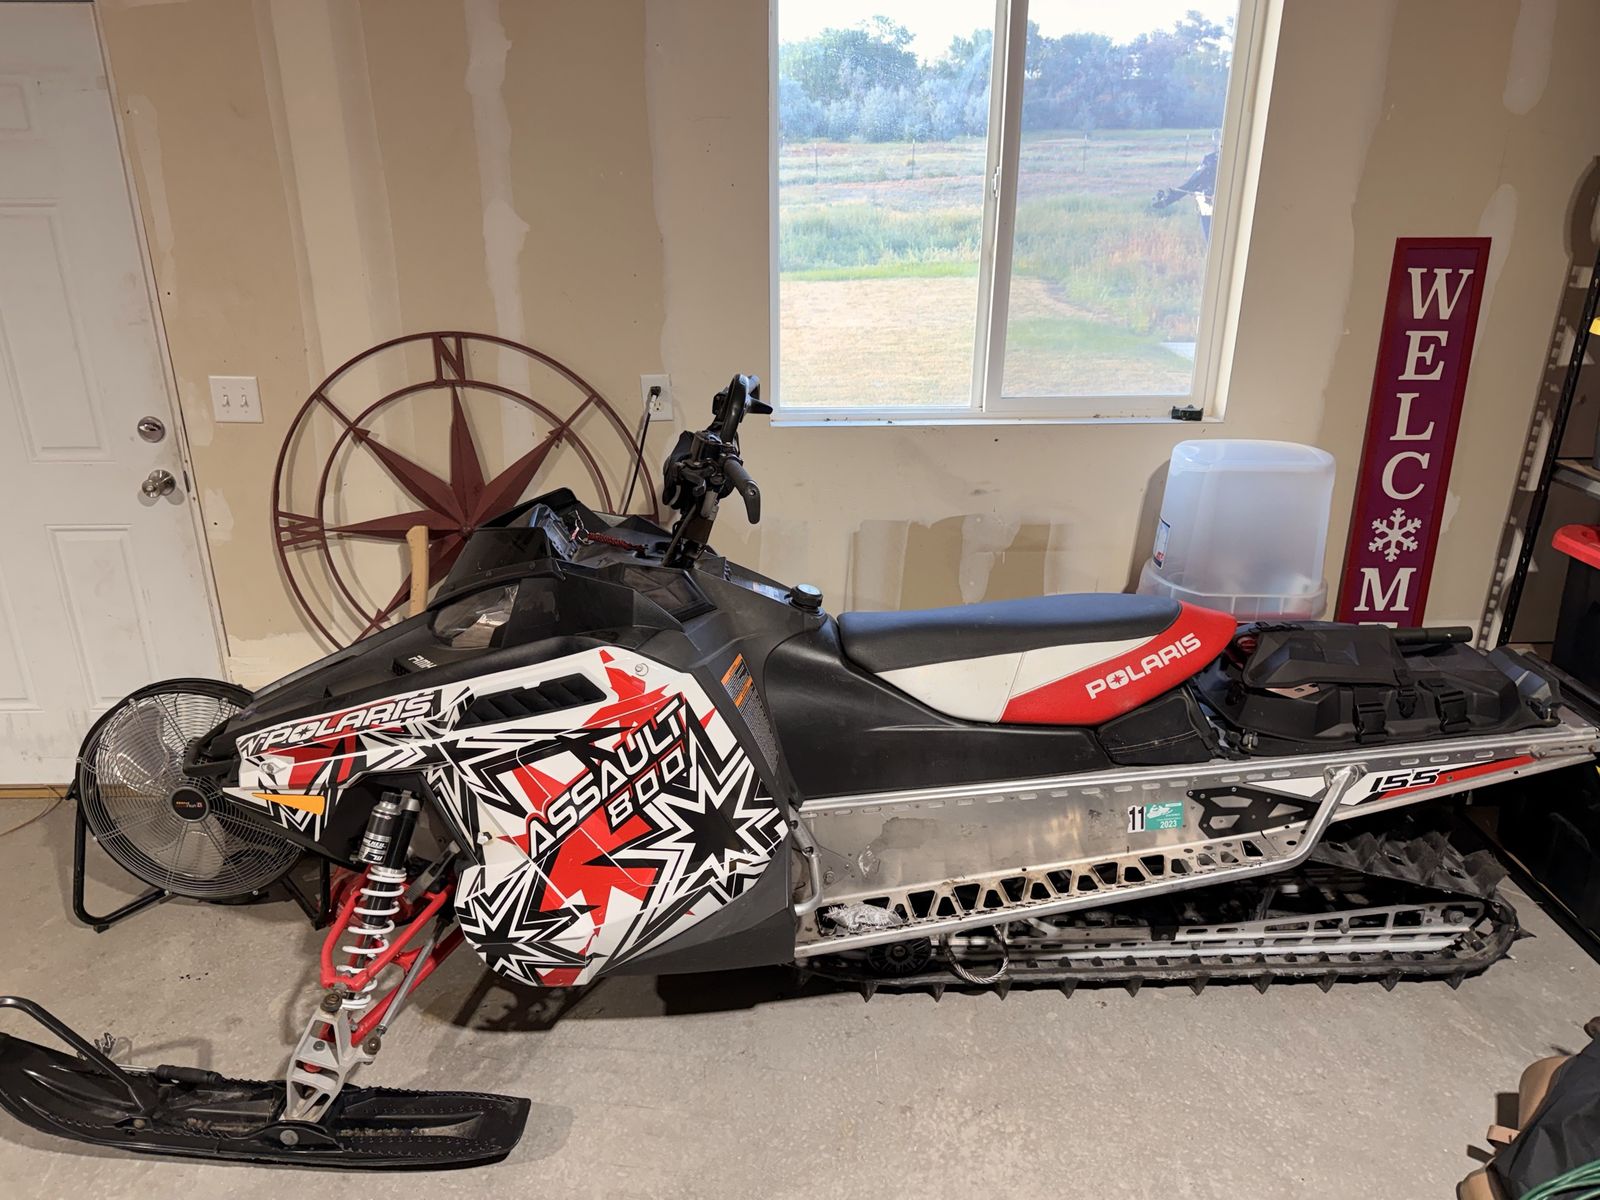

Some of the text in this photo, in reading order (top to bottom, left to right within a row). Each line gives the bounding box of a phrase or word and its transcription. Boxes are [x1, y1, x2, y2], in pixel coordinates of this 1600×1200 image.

[1353, 266, 1474, 627] WELCM
[1085, 632, 1202, 700] POLARIS
[261, 692, 435, 751] POLARIS
[529, 697, 684, 860] ASSAULT
[607, 746, 685, 828] 800
[1369, 768, 1441, 793] 155
[1128, 805, 1145, 831] 11
[1159, 819, 1177, 829] 2023
